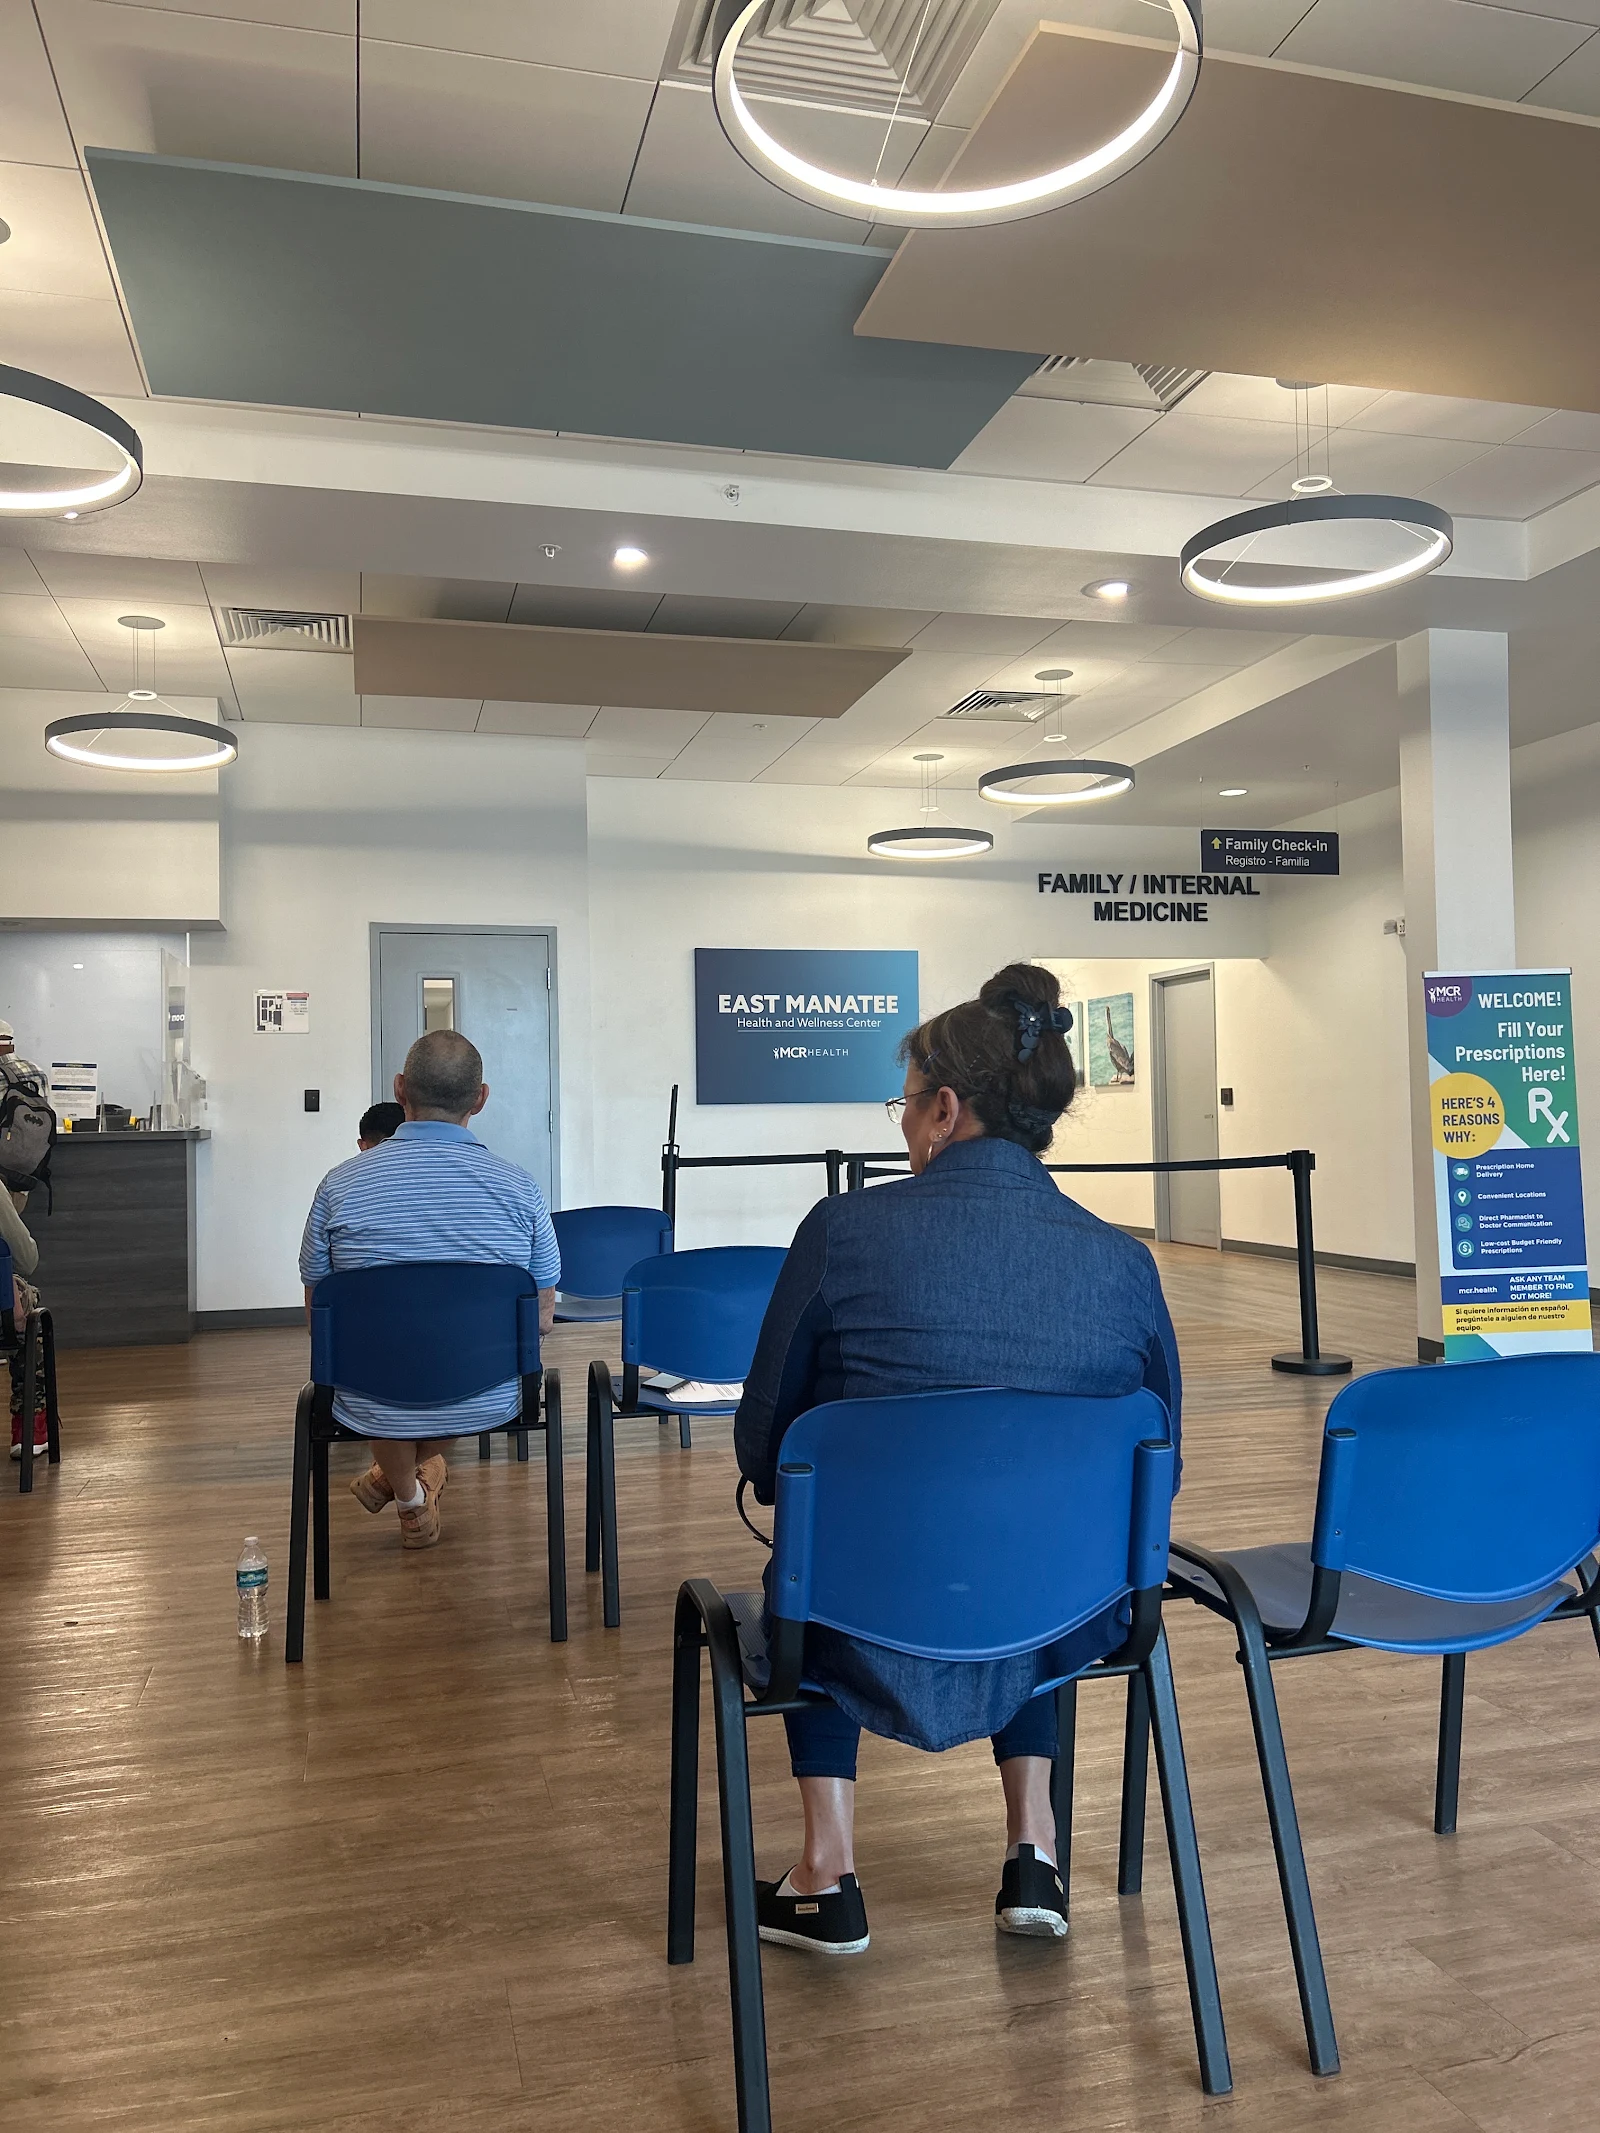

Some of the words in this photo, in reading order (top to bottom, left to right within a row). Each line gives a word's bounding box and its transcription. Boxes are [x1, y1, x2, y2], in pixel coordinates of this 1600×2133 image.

[1225, 838, 1268, 853] Family
[1272, 839, 1328, 852] Check-In
[1225, 855, 1266, 867] Registro
[1275, 856, 1310, 867] Familia
[1038, 873, 1124, 894] FAMILY
[1129, 874, 1137, 894] /
[1143, 874, 1260, 895] INTERNAL
[1094, 902, 1208, 922] MEDICINE
[1436, 985, 1461, 997] MCR
[718, 994, 780, 1014] EAST
[785, 994, 899, 1014] MANATEE
[1478, 991, 1562, 1009] WELCOME!
[737, 1018, 773, 1028] Health
[775, 1018, 795, 1028] and
[797, 1018, 844, 1028] Wellness
[846, 1018, 881, 1028] Center
[1498, 1022, 1522, 1038] Fill
[1525, 1021, 1563, 1037] Your
[1456, 1044, 1565, 1063] Prescriptions
[1522, 1066, 1566, 1082] Here!
[1442, 1097, 1484, 1110] HERE'S
[1487, 1096, 1495, 1108] 4
[1443, 1113, 1500, 1126] REASONS
[1444, 1131, 1476, 1143] WHY:
[1476, 1163, 1515, 1171] Prescription
[1476, 1171, 1503, 1179] Delivery
[1478, 1192, 1514, 1200] Convenient
[1515, 1191, 1547, 1199] Locations
[1500, 1213, 1536, 1221] Pharmacist
[1511, 1239, 1535, 1247] Budget
[1535, 1238, 1562, 1246] Friendly
[1481, 1247, 1523, 1255] Prescriptions
[1458, 1286, 1498, 1295] mcr.health
[1510, 1284, 1543, 1292] MEMBER
[1463, 1307, 1486, 1315] quiere
[1487, 1306, 1529, 1314] información
[1456, 1316, 1494, 1324] pregúntele
[1501, 1314, 1527, 1322] alguien
